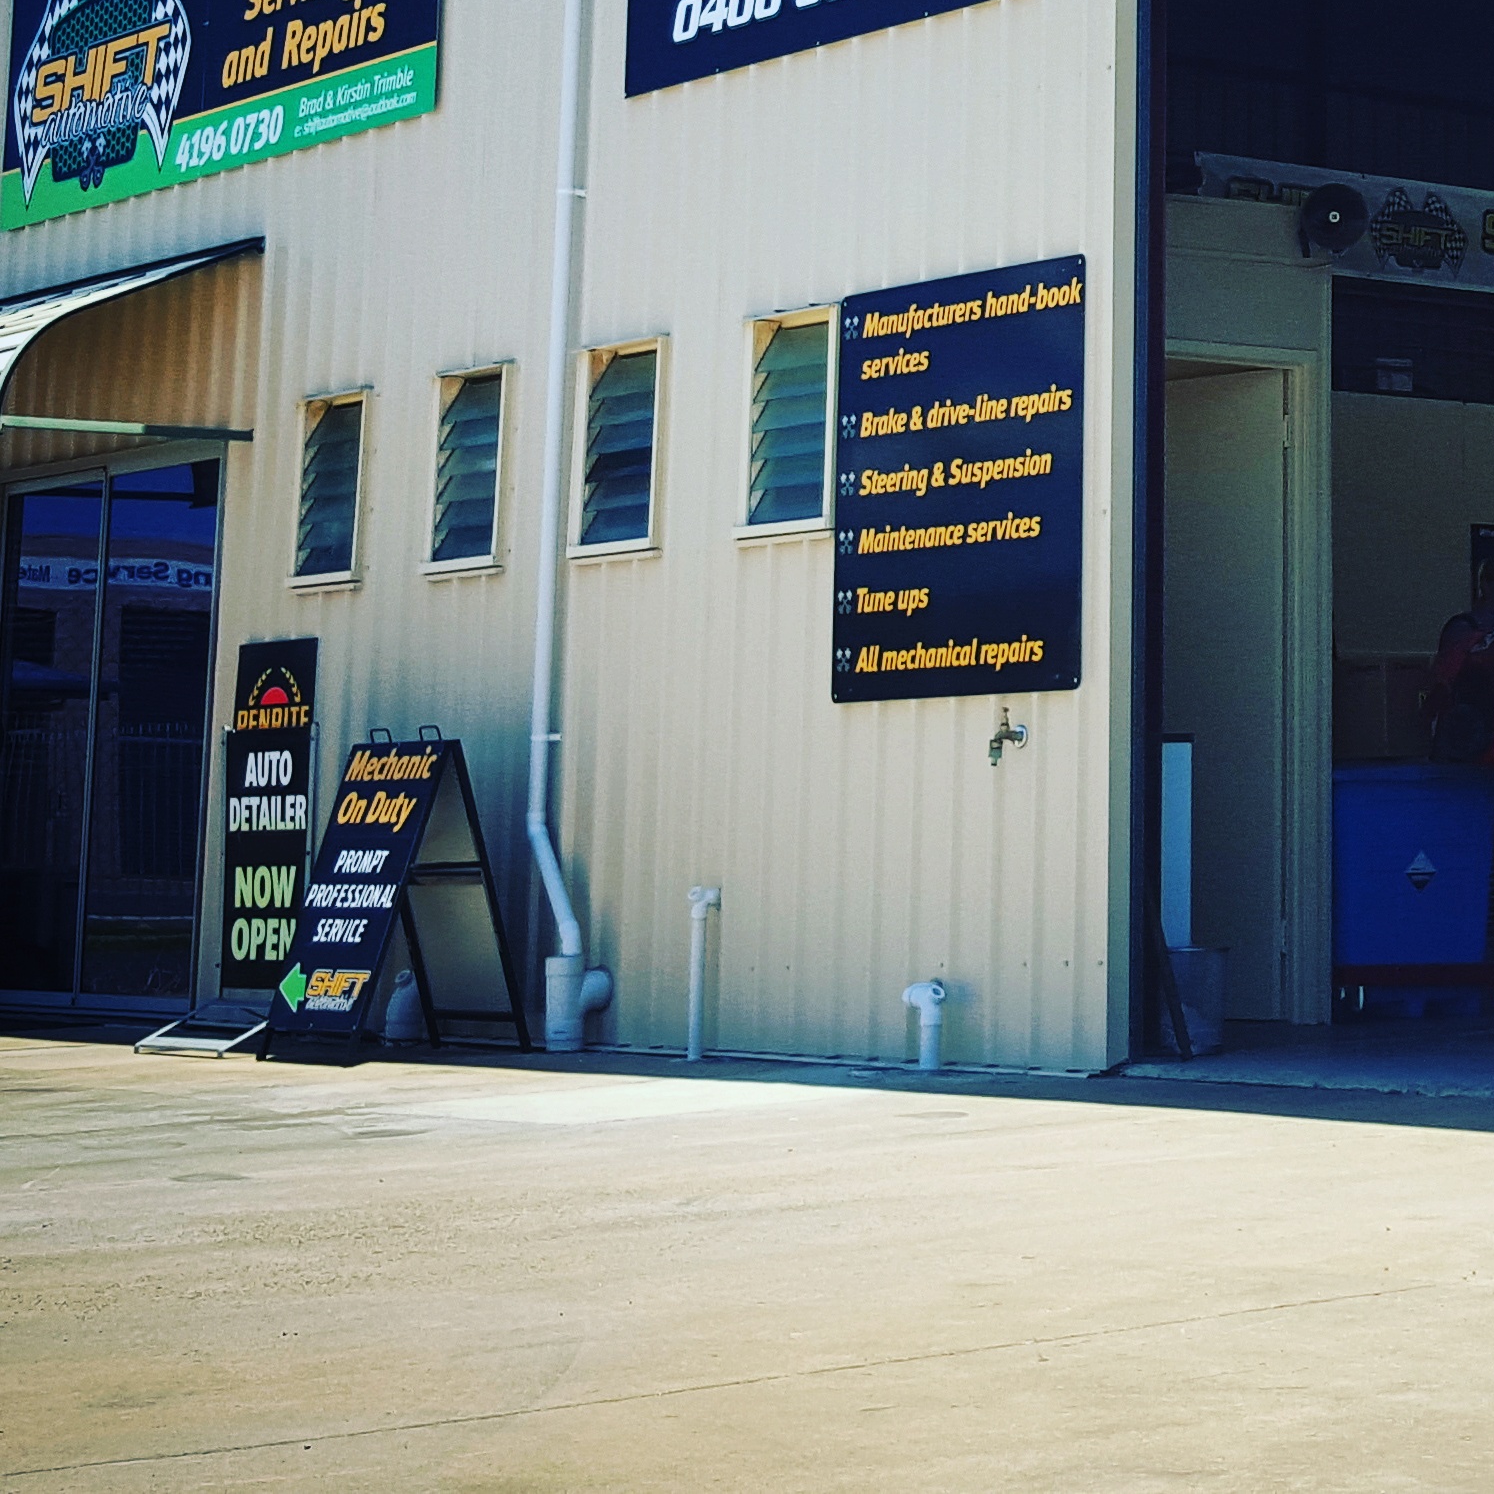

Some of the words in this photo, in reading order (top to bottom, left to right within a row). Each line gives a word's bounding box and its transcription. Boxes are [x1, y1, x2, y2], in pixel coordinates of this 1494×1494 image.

[221, 23, 273, 89] and
[281, 1, 387, 73] Repairs
[32, 23, 172, 123] SHIFT
[298, 90, 324, 118] Brad
[325, 90, 335, 108] &
[373, 64, 415, 95] Trimble
[41, 82, 151, 148] automotive
[175, 120, 227, 174] 4196
[230, 105, 284, 156] 0730
[1380, 223, 1448, 248] SHIFT
[863, 300, 982, 338] Manufacturers
[984, 277, 1083, 318] hand-book
[861, 348, 929, 380] services
[860, 408, 906, 438] Brake
[910, 406, 923, 431] &
[927, 394, 1006, 428] drive-line
[1010, 384, 1072, 422] repairs
[859, 463, 929, 497] Steering
[931, 462, 945, 488] &
[948, 448, 1052, 489] Suspension
[858, 522, 963, 554] Maintenance
[966, 512, 1041, 543] services
[856, 588, 893, 614] Tune
[898, 587, 929, 616] ups
[855, 645, 880, 673] All
[881, 638, 977, 671] mechanical
[980, 634, 1043, 671] repairs
[244, 750, 293, 788] AUTO
[345, 745, 439, 782] Mechanic
[229, 794, 306, 832] DETAILER
[336, 792, 372, 825] On
[370, 792, 417, 832] Duty
[334, 850, 389, 873] PROMPT
[234, 866, 296, 908] NOW
[304, 884, 396, 908] PROFESSIONAL
[231, 918, 296, 961] OPEN
[312, 919, 368, 943] SERVICE
[306, 969, 371, 1000] SHIFT
